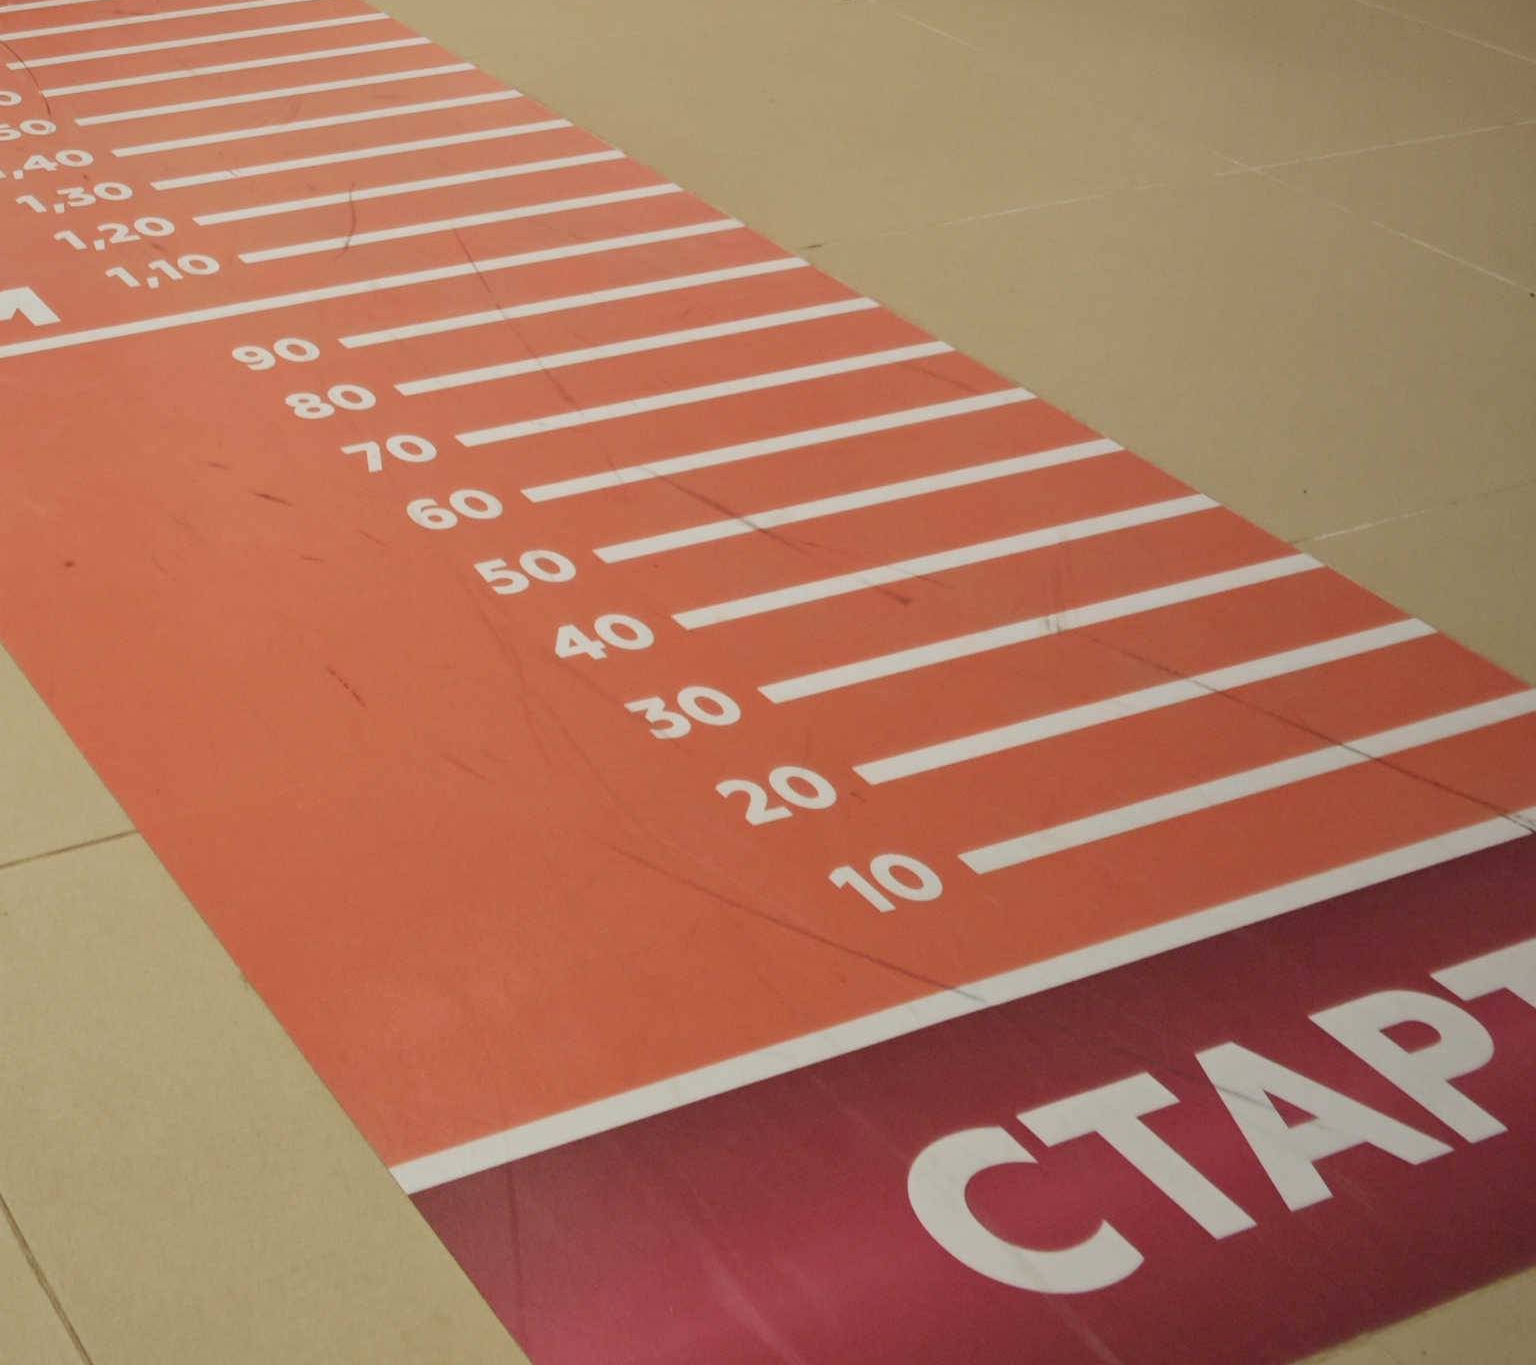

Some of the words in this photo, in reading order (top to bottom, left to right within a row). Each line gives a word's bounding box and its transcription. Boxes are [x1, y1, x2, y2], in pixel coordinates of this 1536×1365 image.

[15, 181, 134, 214] 1,30
[54, 216, 176, 251] 1,20
[105, 253, 221, 289] 1,10
[231, 337, 321, 371] 90
[285, 383, 377, 420] 80
[341, 434, 438, 473] 70
[406, 488, 504, 530] 60
[474, 549, 577, 595] 50
[555, 613, 655, 660] 40
[625, 685, 742, 740] 30
[715, 765, 838, 826] 20
[829, 852, 944, 913] 10
